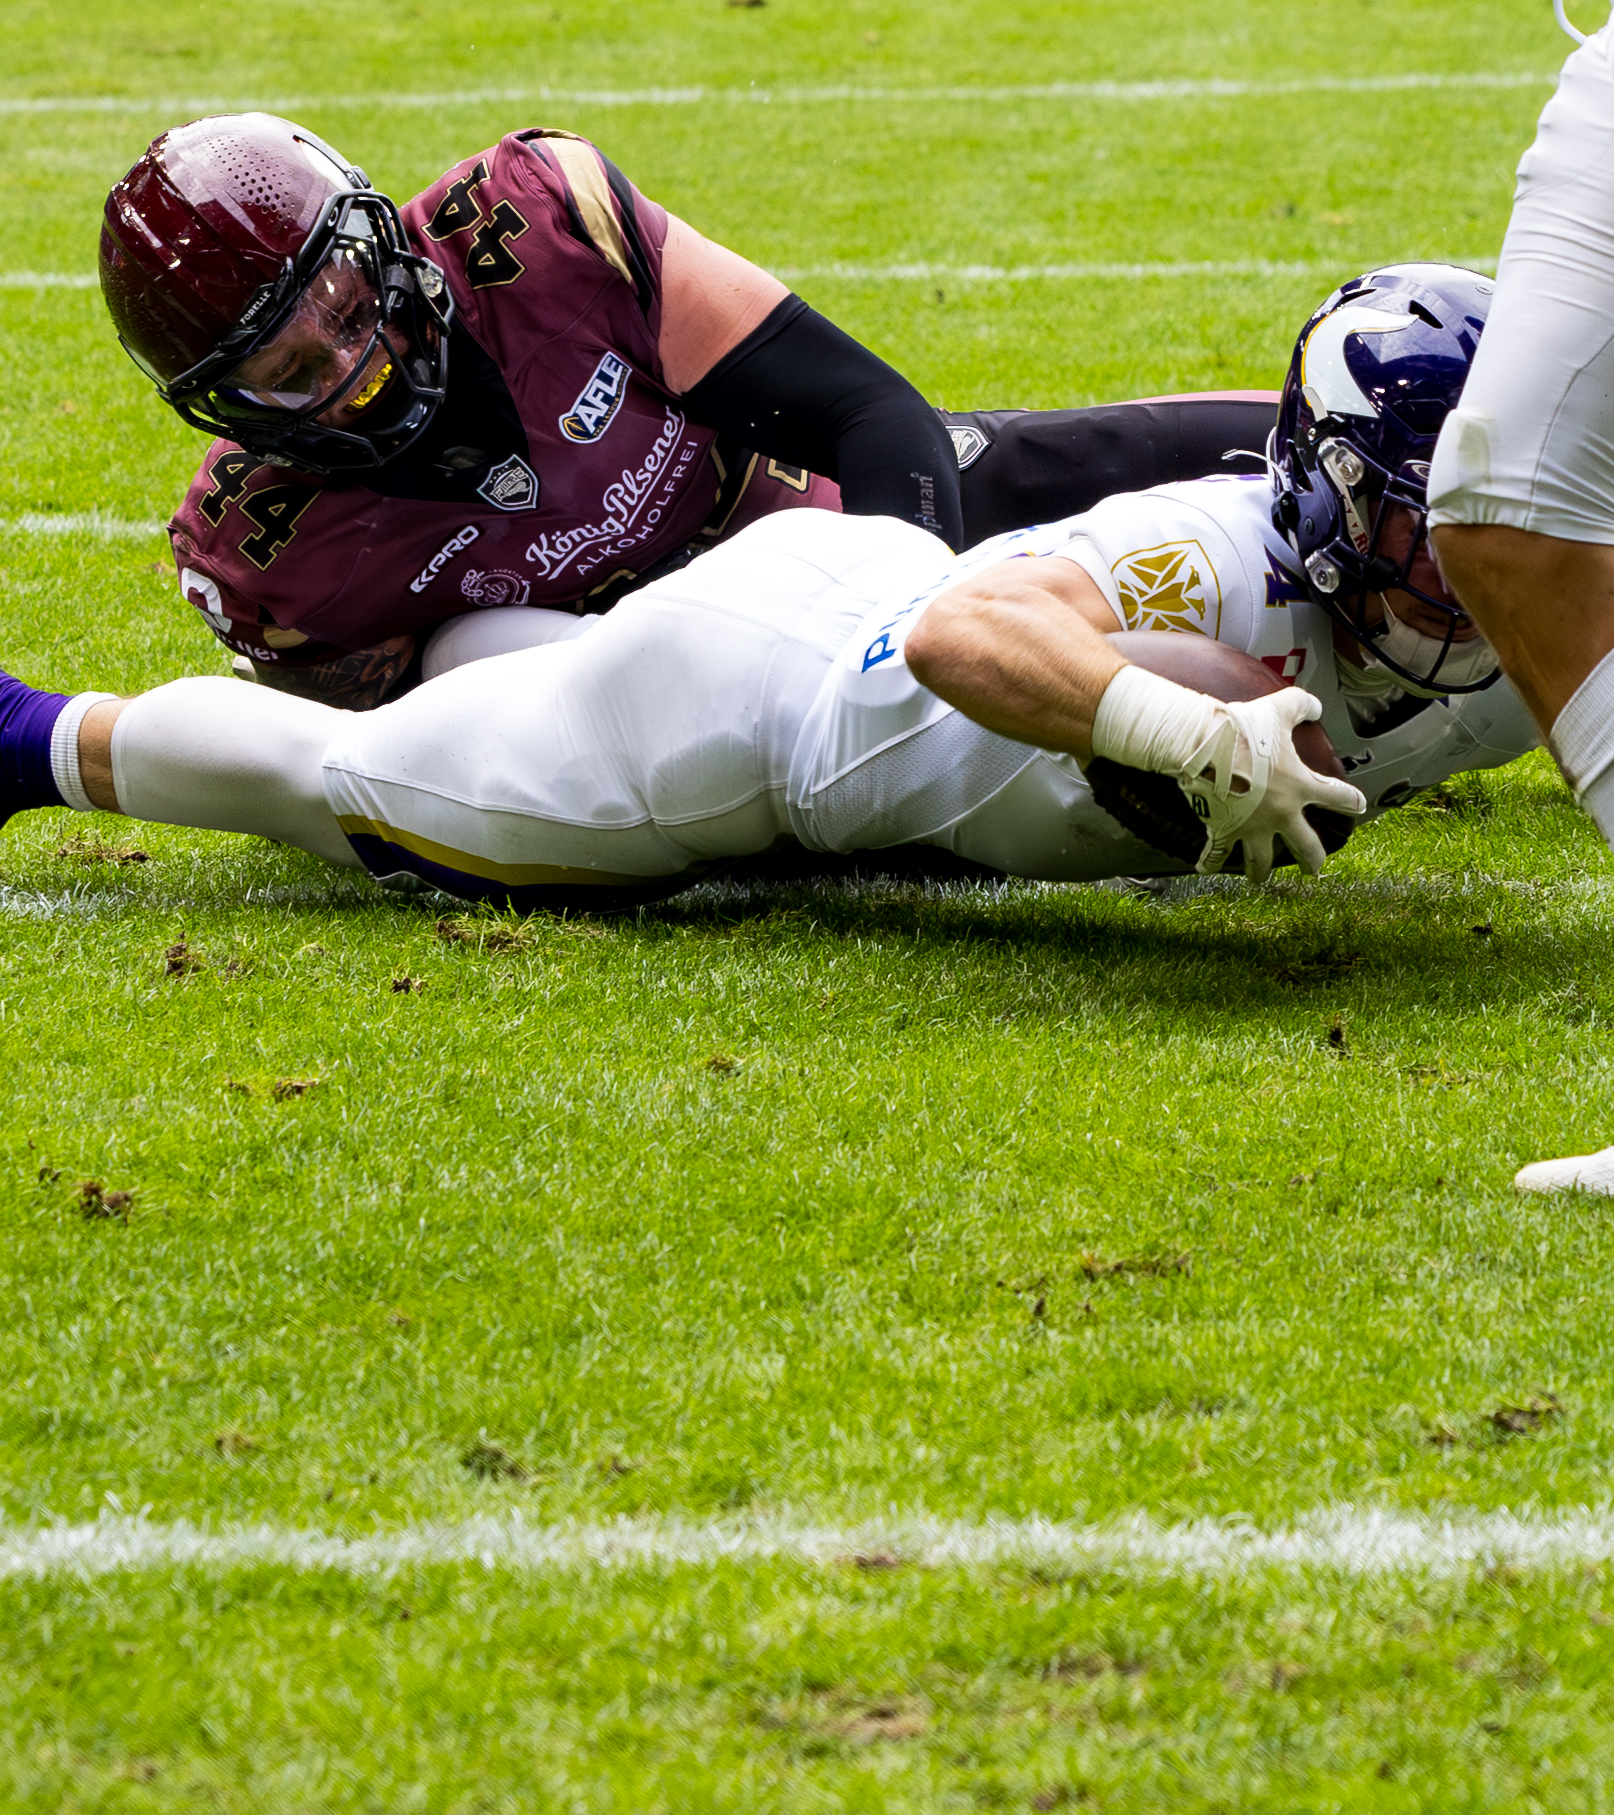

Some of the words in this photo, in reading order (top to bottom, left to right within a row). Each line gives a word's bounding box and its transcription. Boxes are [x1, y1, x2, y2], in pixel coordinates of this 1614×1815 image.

[421, 157, 530, 291] 44
[240, 290, 272, 325] FORELLE
[575, 356, 624, 434] AFLE
[198, 450, 323, 572] 44
[525, 516, 626, 577] König
[603, 404, 684, 523] Pilsener
[576, 440, 699, 576] ALKOHOLFREI
